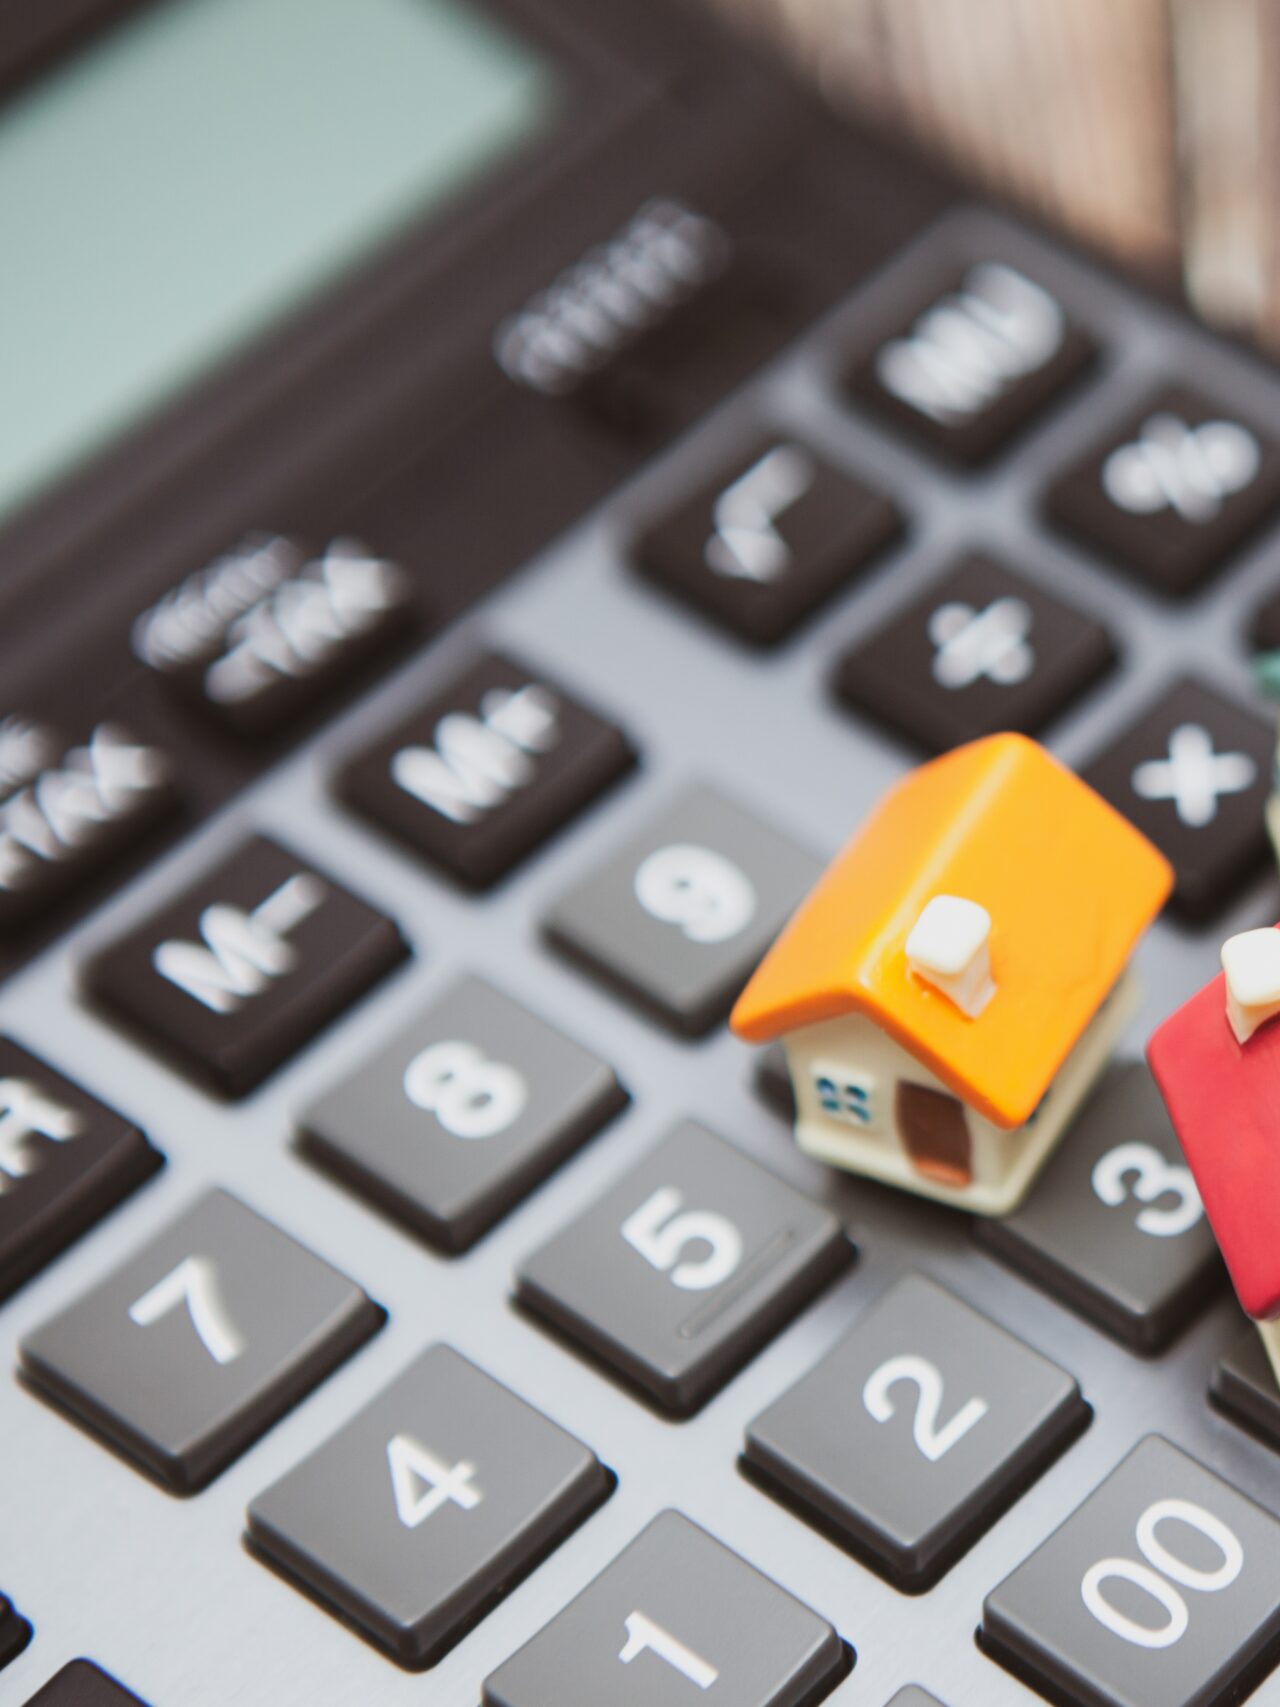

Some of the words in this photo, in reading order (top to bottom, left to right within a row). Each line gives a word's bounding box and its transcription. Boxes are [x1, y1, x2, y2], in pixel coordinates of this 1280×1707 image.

[391, 684, 562, 823] M+
[152, 872, 323, 1013] M-
[634, 844, 756, 944] 9
[404, 1041, 526, 1138] 8
[620, 1187, 743, 1290] 5
[1092, 1142, 1206, 1237] 3
[129, 1257, 243, 1364] 7
[863, 1356, 988, 1462] 2
[387, 1434, 483, 1528] 4
[1081, 1499, 1243, 1648] 00
[619, 1610, 718, 1689] 1
